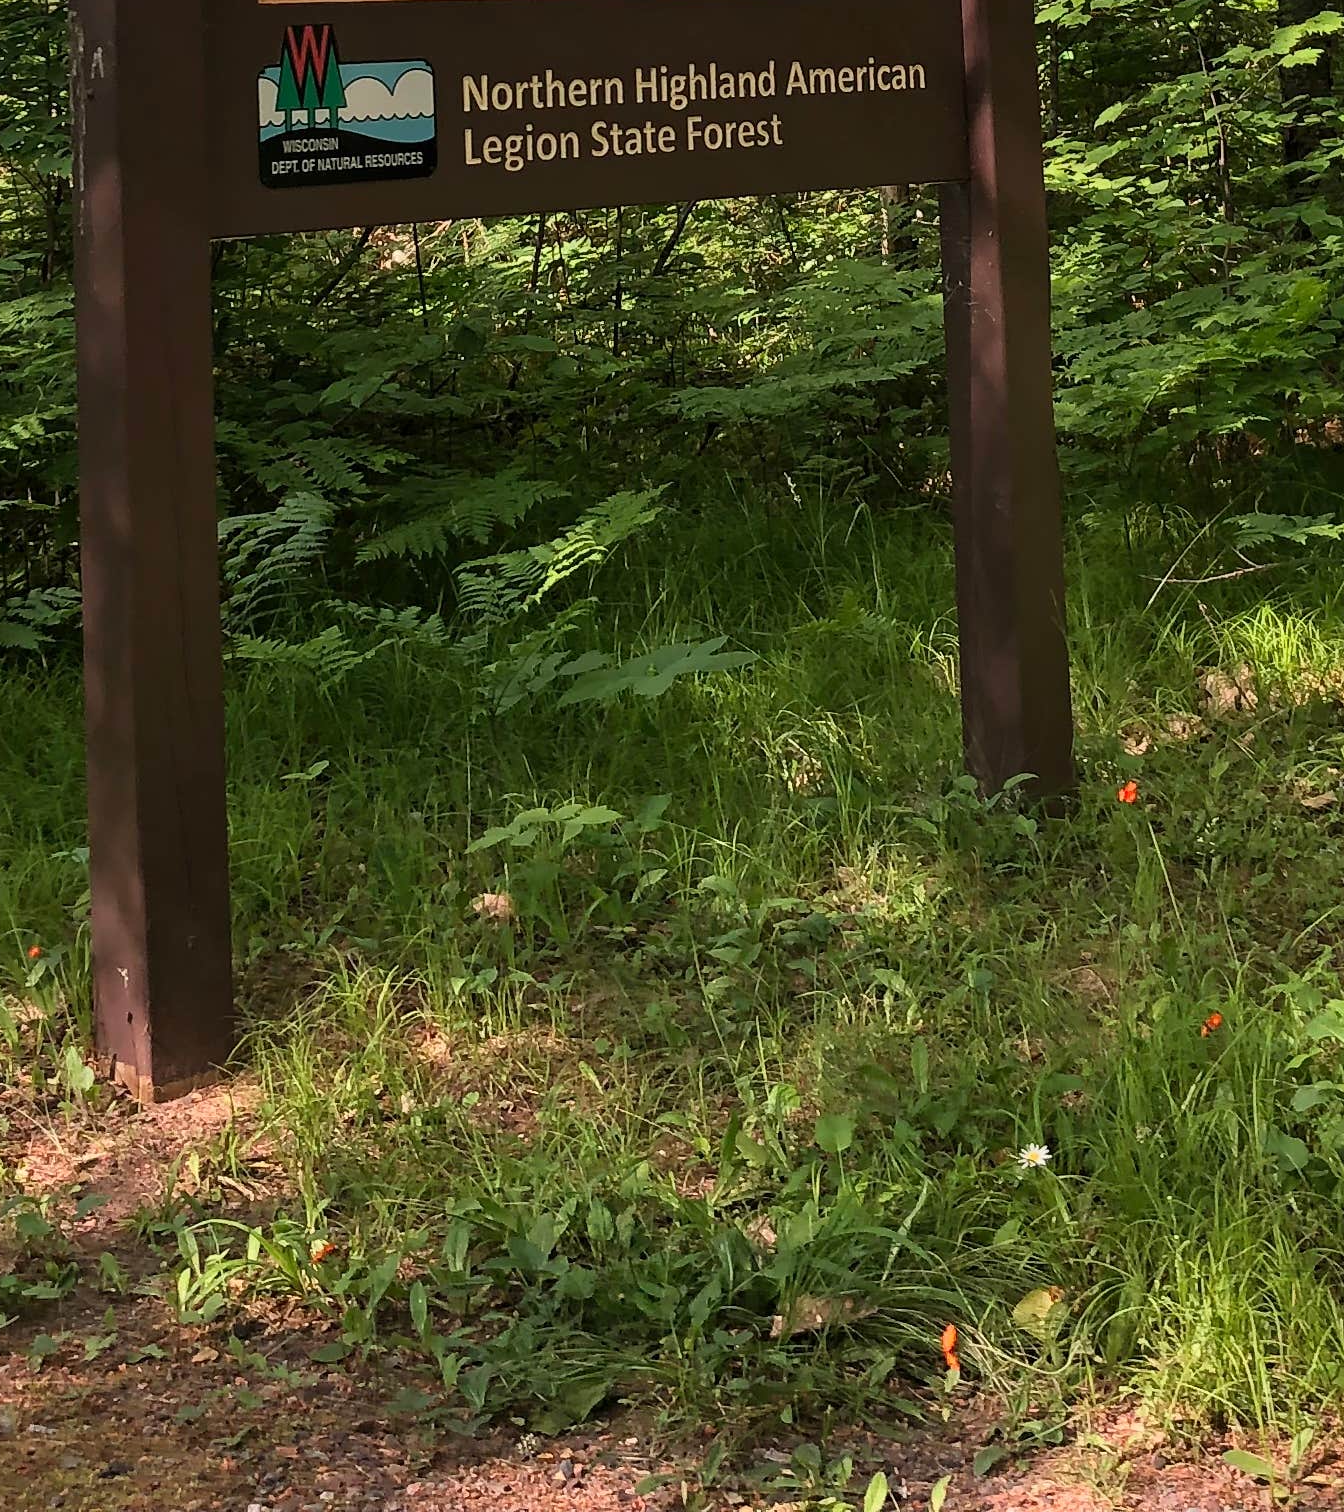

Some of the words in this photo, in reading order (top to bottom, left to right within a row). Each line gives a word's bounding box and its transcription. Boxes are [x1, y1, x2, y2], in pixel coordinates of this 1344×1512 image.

[462, 69, 624, 112] Northern
[635, 60, 776, 111] Highland
[785, 57, 926, 96] American
[282, 137, 339, 154] WISCONSIN
[464, 124, 580, 172] Legion
[591, 120, 676, 158] State
[686, 113, 784, 151] Forest
[271, 160, 300, 175] DEPT.
[301, 158, 316, 173] OF
[317, 155, 363, 171] NATURAL
[364, 151, 424, 168] RESOURCES
